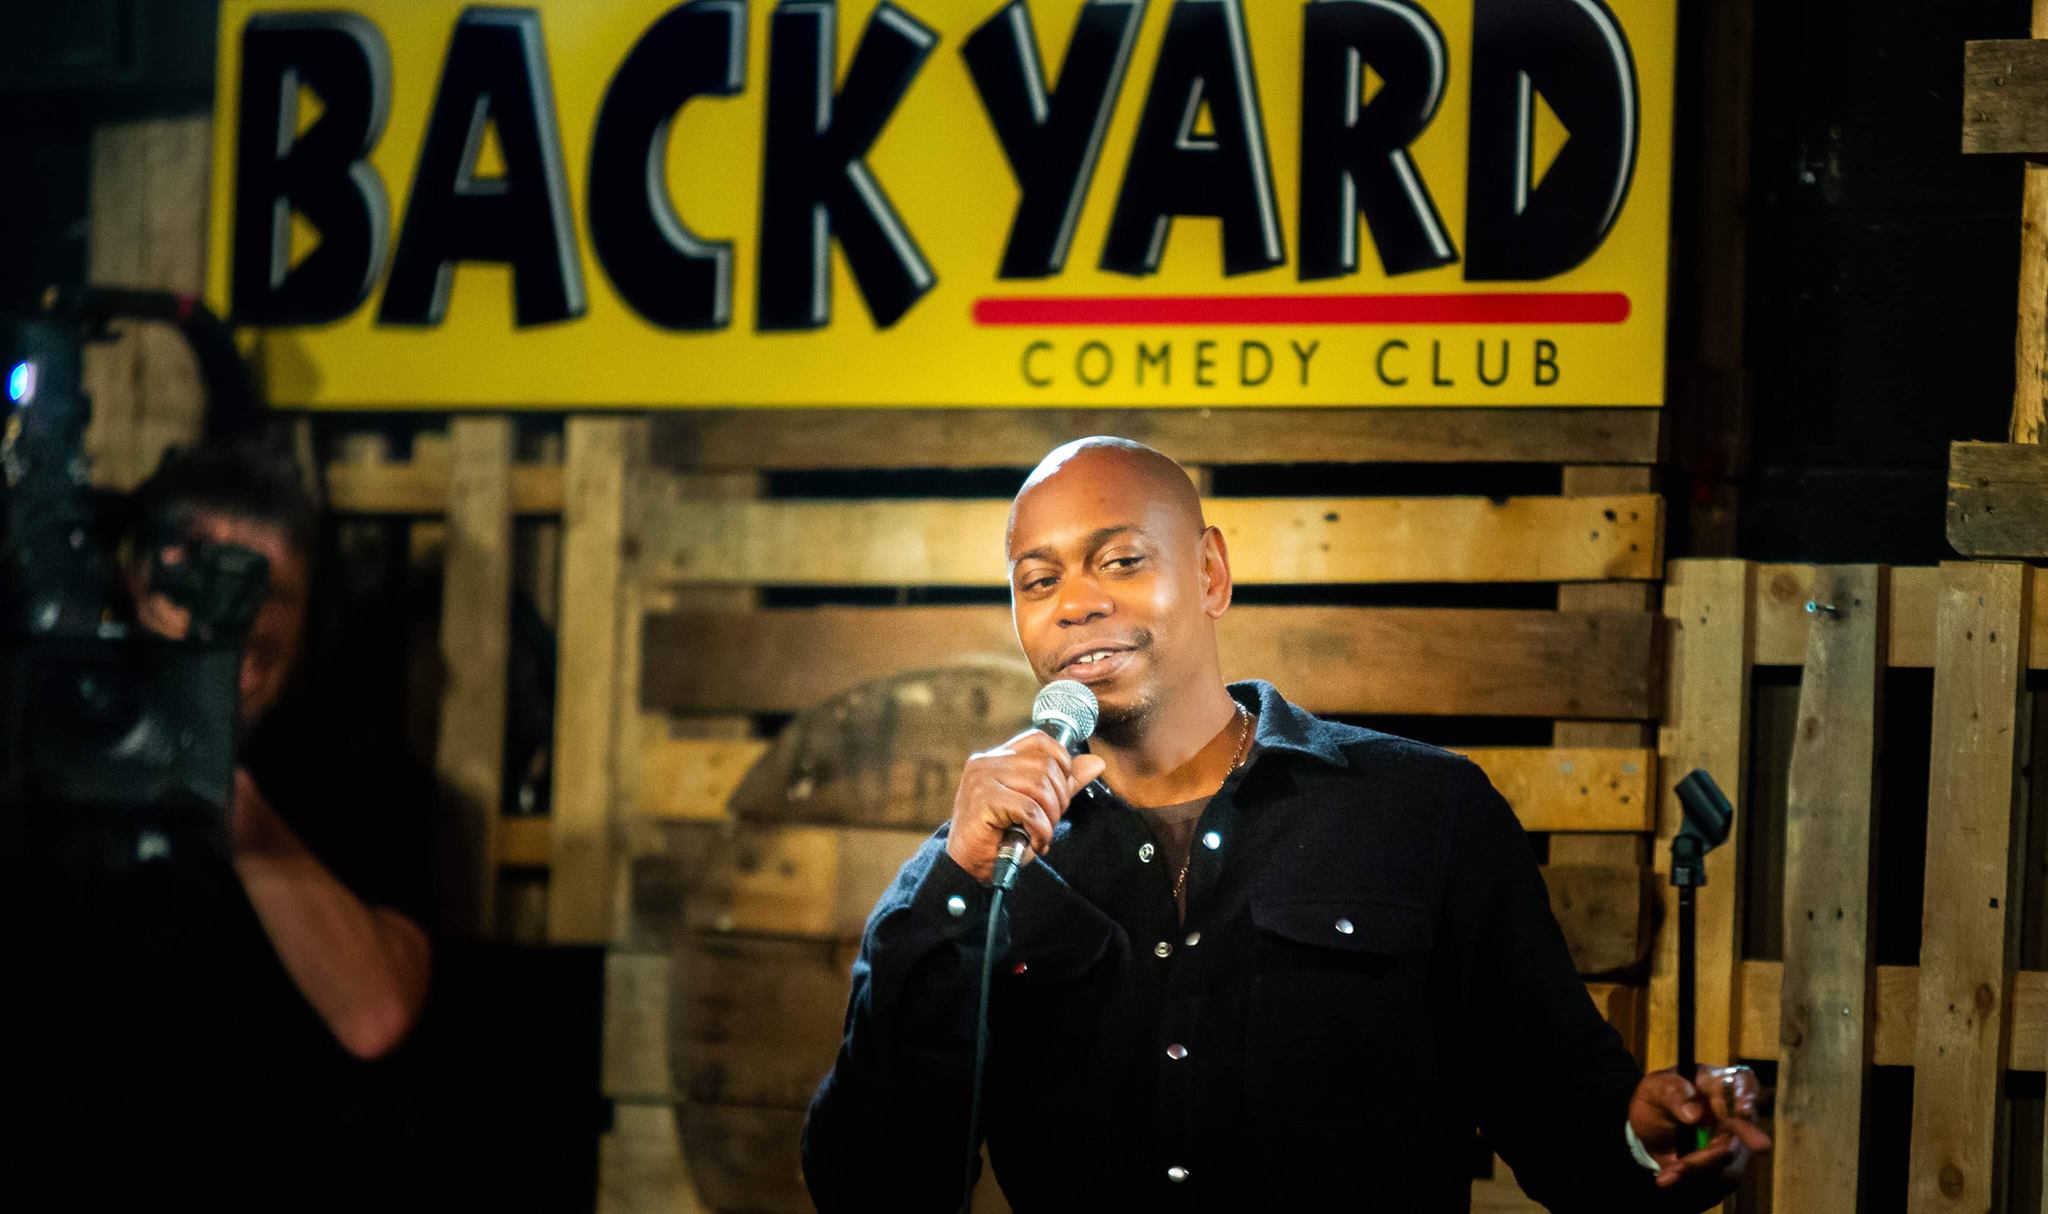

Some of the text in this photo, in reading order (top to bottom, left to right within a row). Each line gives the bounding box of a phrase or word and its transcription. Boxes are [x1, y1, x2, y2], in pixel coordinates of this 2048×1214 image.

[229, 0, 1641, 335] BACKYARD
[1020, 339, 1562, 387] COMEDY CLUB
